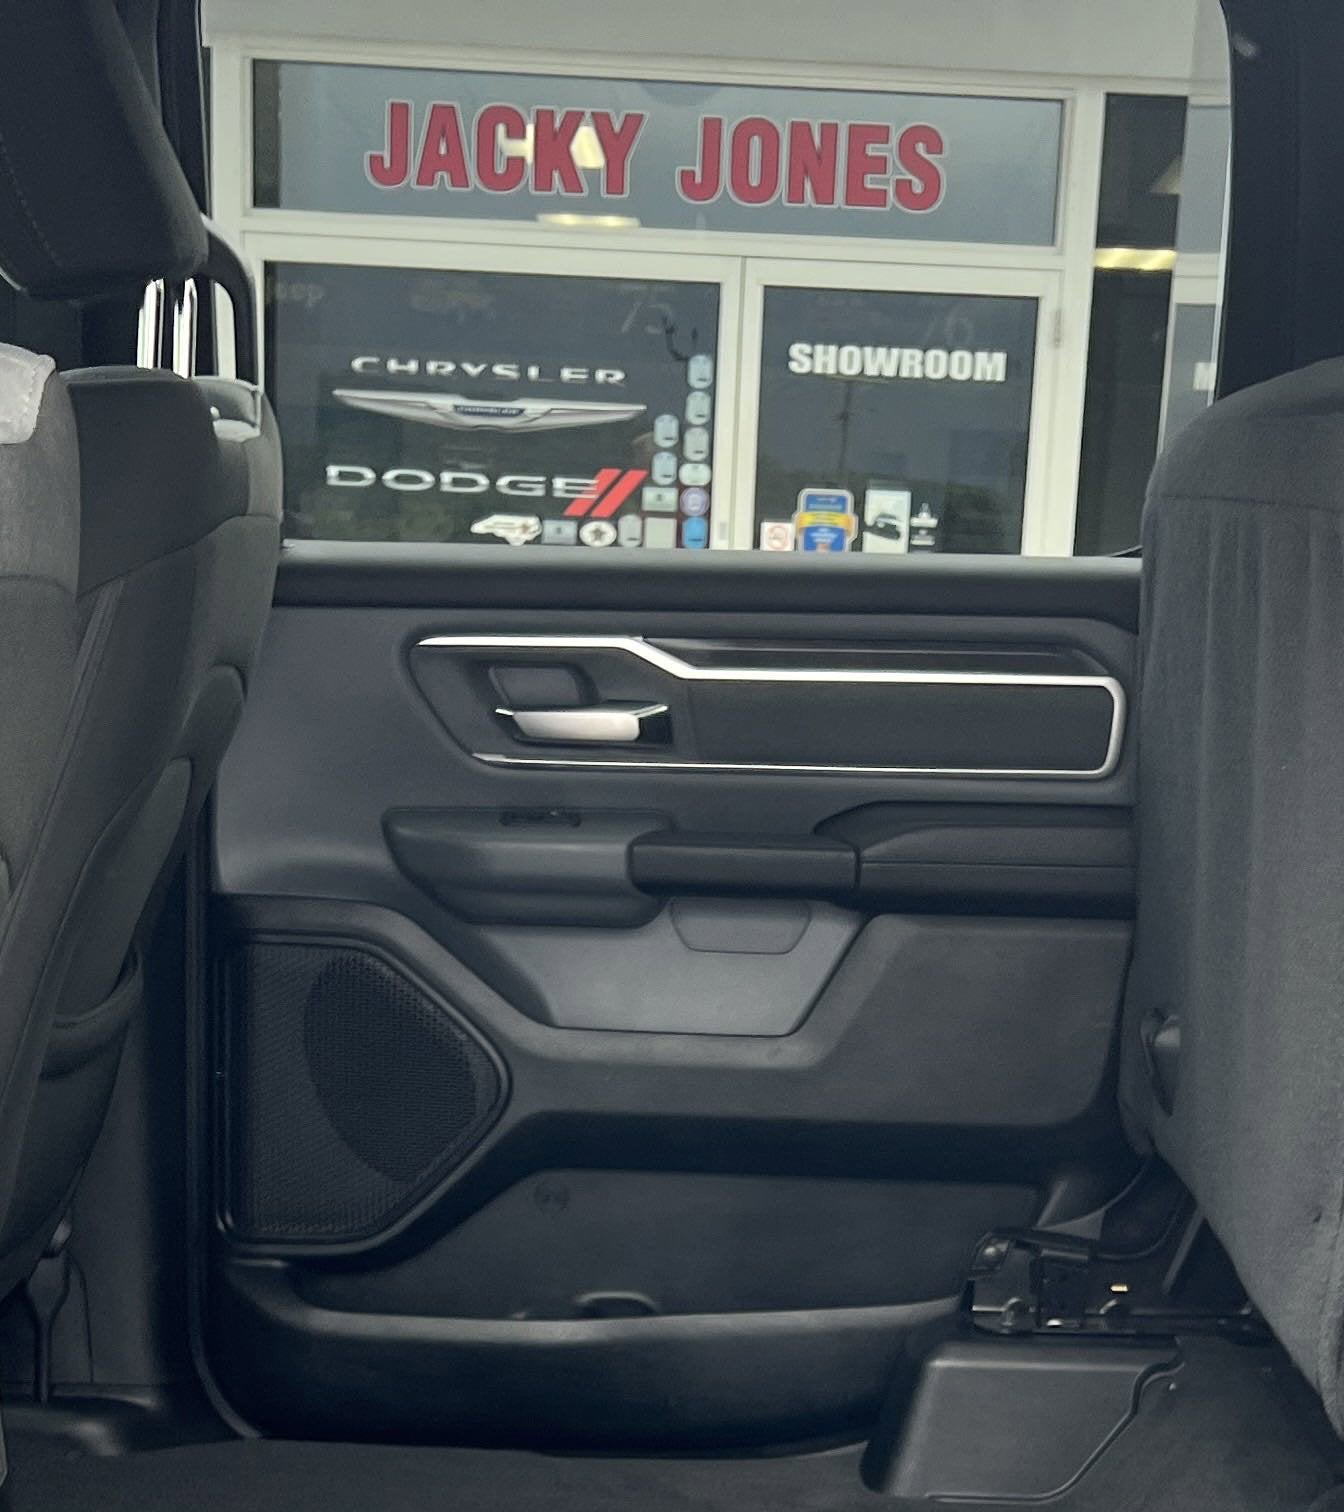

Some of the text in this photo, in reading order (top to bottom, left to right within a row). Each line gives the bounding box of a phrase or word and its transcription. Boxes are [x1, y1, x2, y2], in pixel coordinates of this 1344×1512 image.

[366, 101, 946, 212] JACKY JONES
[351, 356, 626, 386] CHRYSLER
[788, 343, 1007, 382] SHOWROOM
[326, 465, 600, 499] DODGE
